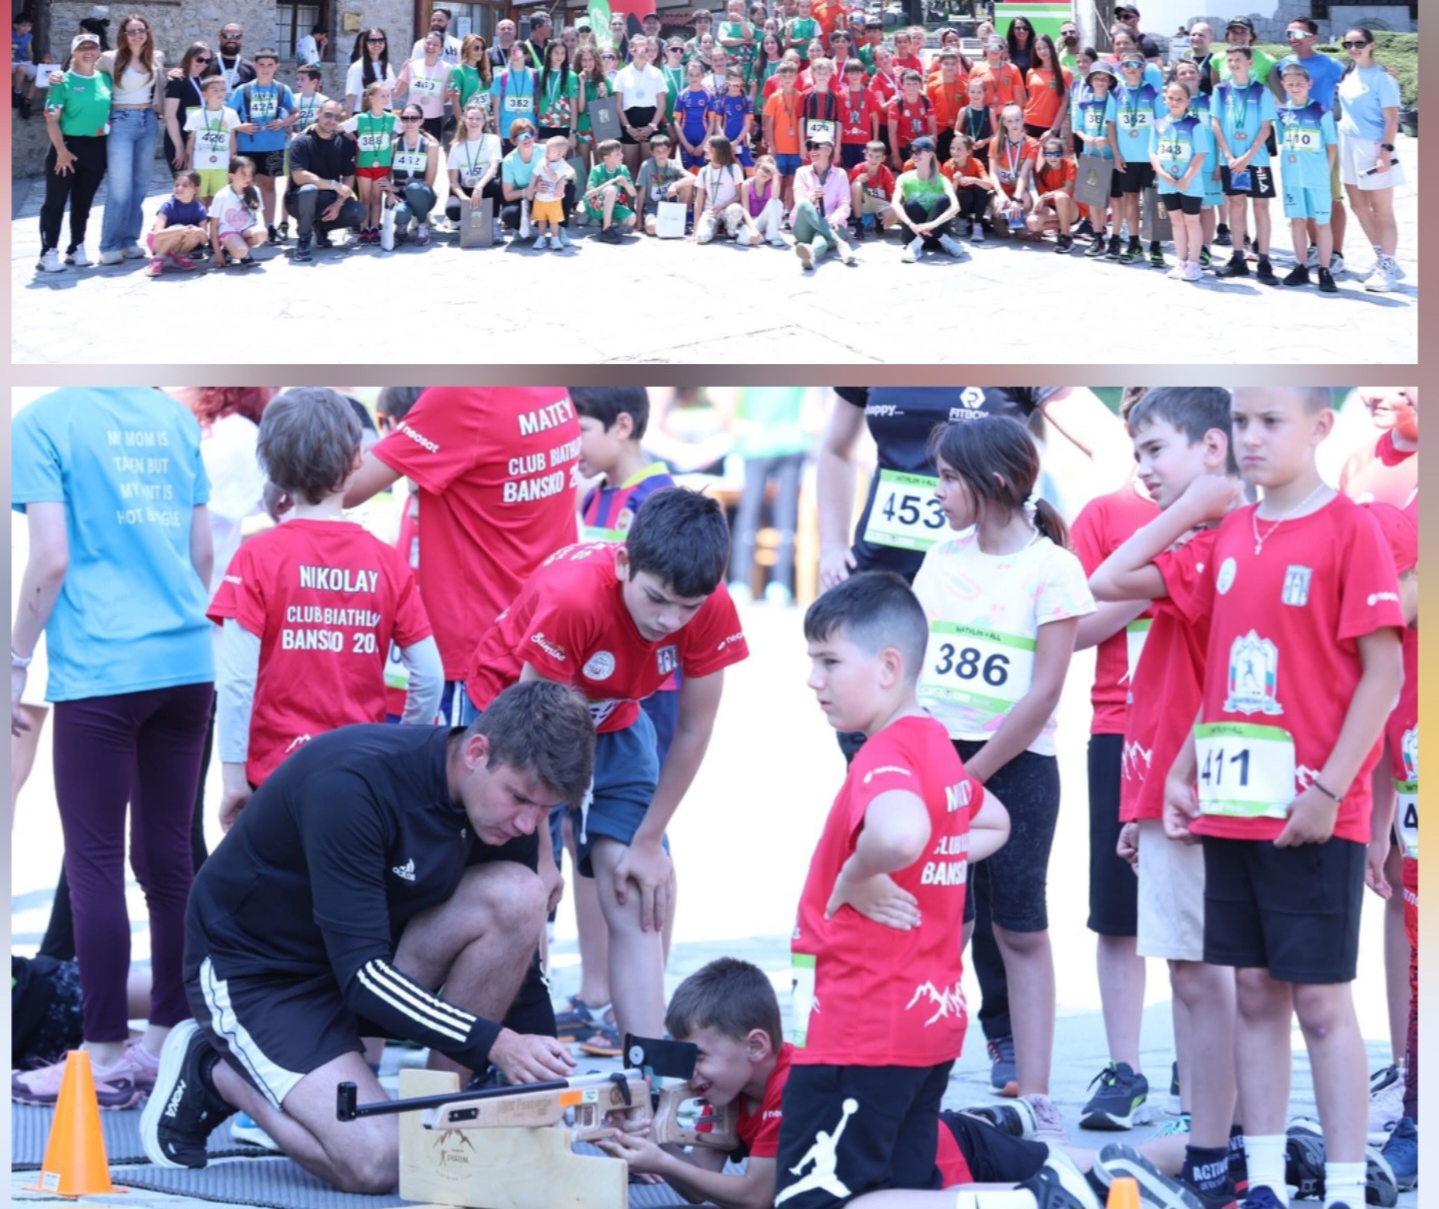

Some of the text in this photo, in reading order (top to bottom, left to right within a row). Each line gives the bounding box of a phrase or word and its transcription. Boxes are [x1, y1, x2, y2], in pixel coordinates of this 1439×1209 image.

[518, 398, 574, 436] MATEY
[402, 425, 440, 454] neosat
[508, 453, 546, 476] CLUB
[503, 471, 564, 503] BANSKO
[882, 492, 946, 529] 453
[299, 565, 379, 593] NIKOLAY
[286, 606, 322, 623] CLUB
[935, 642, 1011, 687] 386
[1202, 748, 1250, 787] 411
